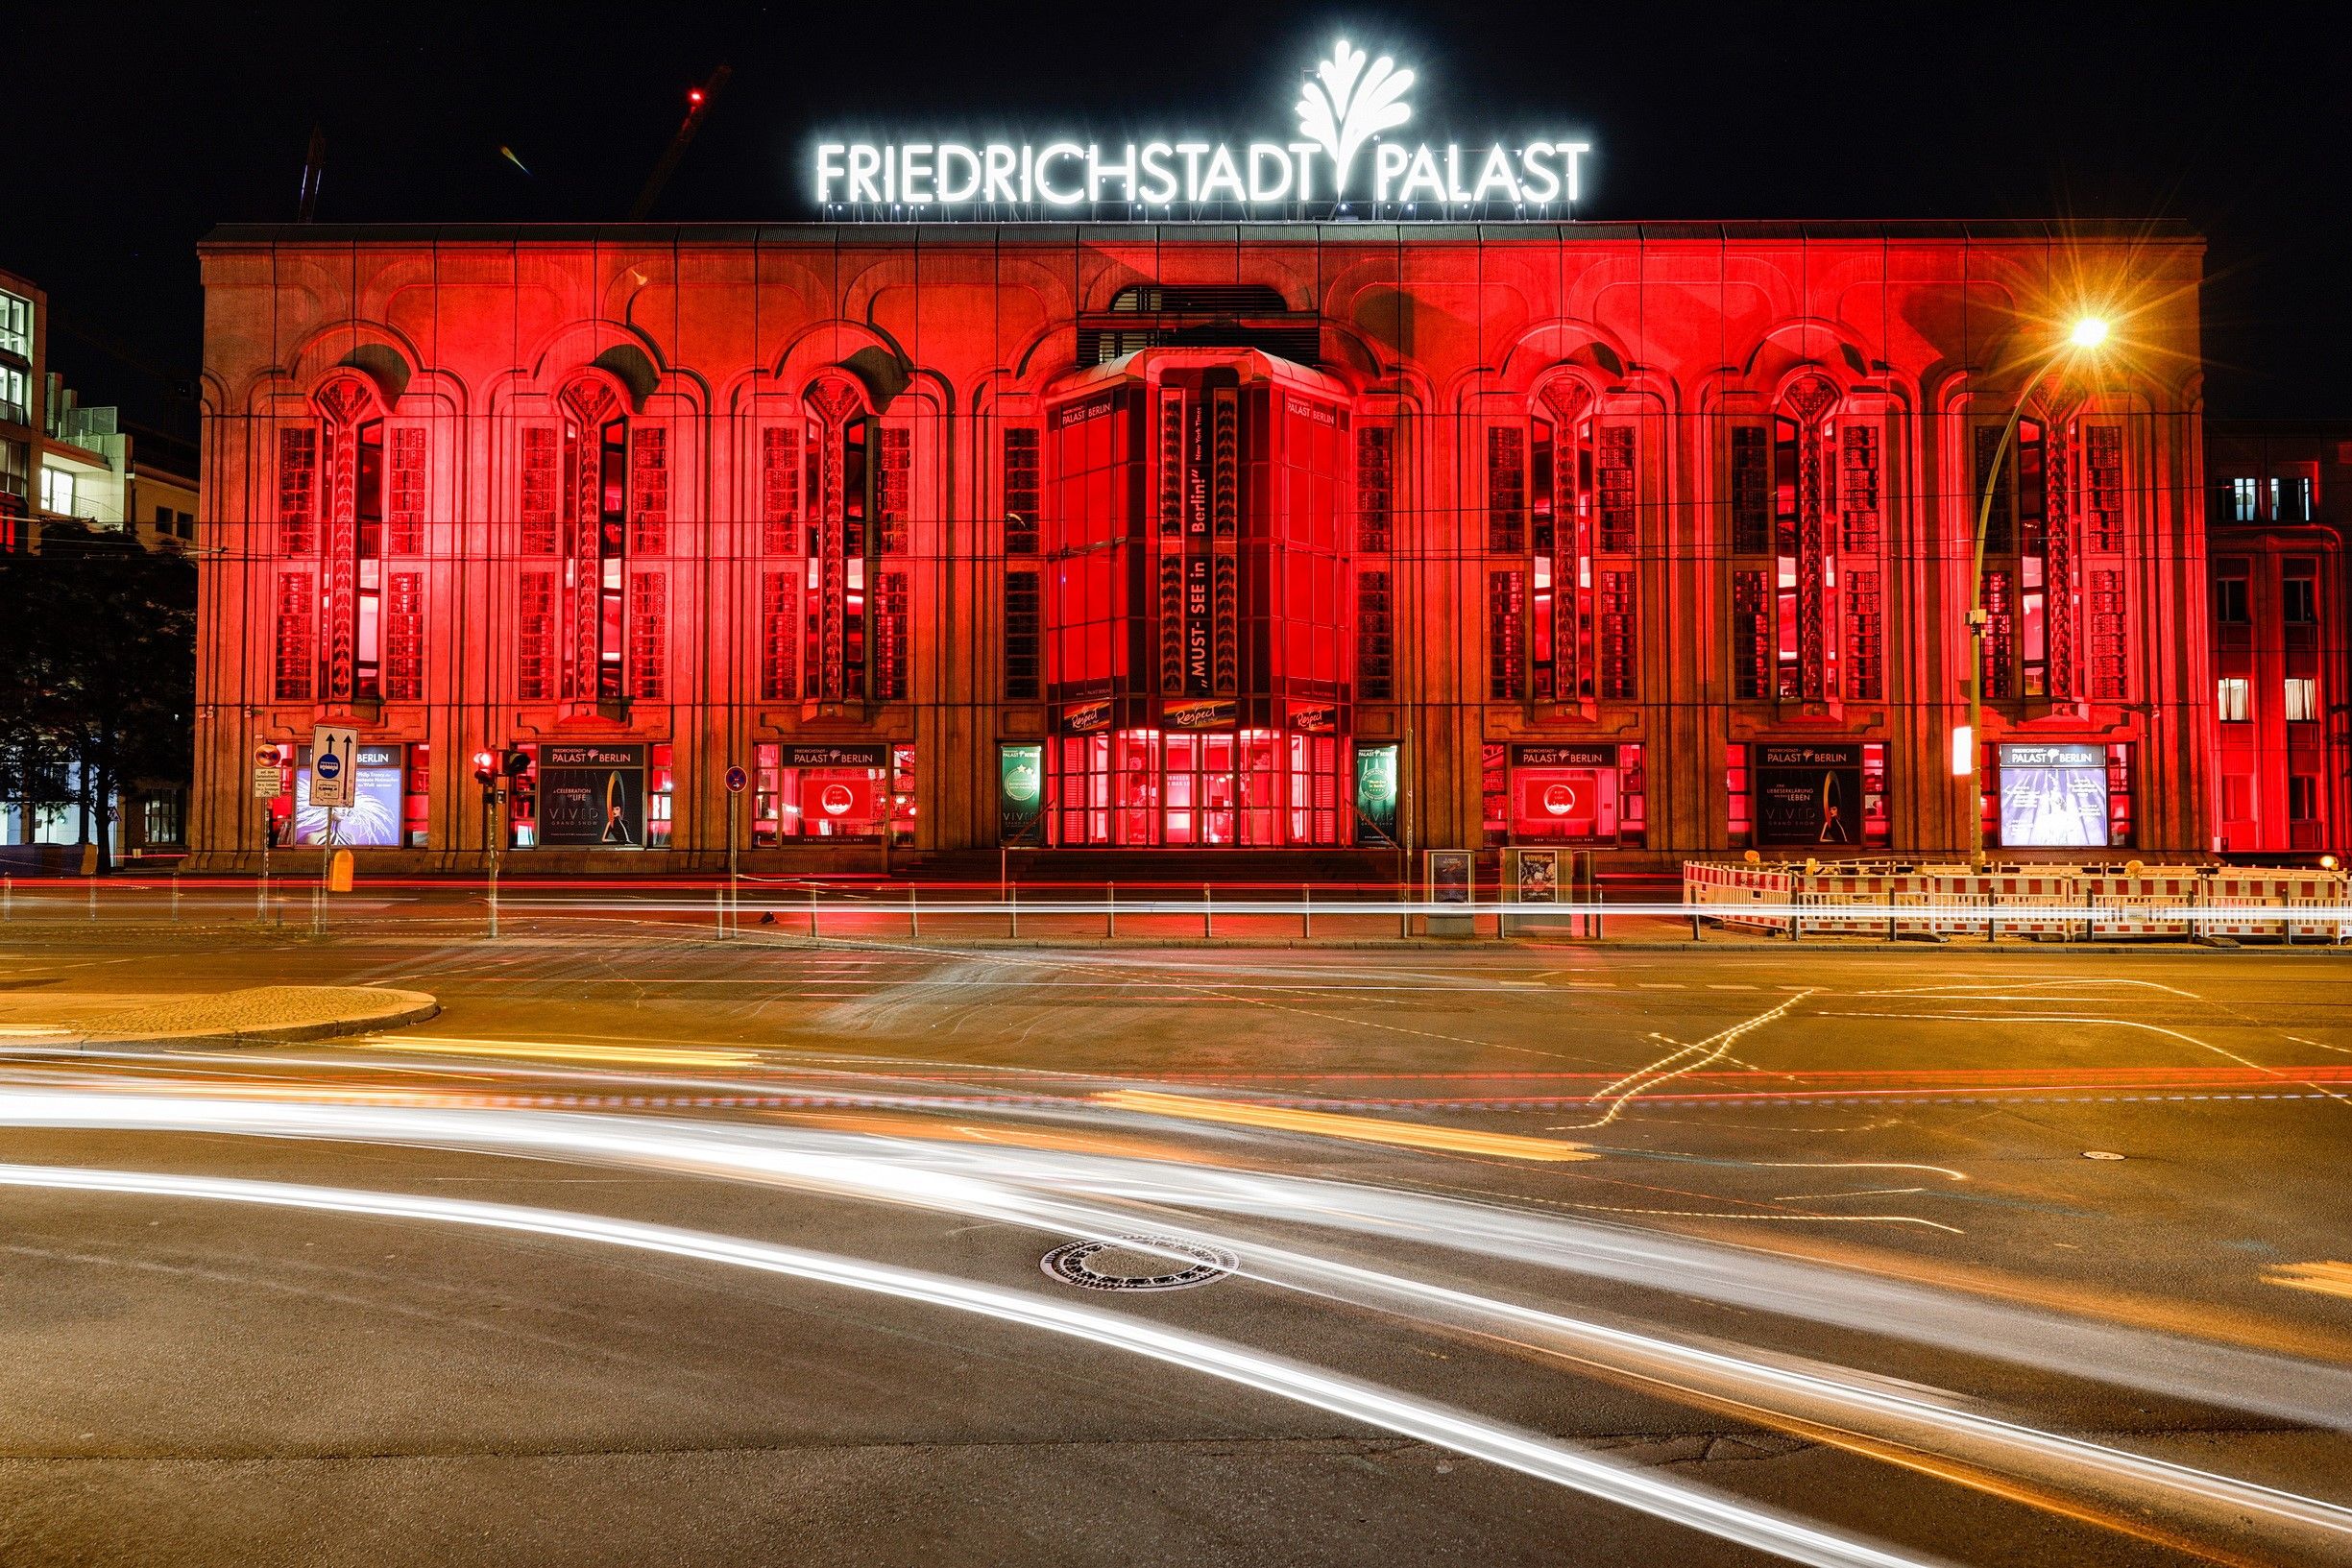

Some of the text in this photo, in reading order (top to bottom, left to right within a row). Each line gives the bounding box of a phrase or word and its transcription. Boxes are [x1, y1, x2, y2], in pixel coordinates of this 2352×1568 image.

[817, 142, 1590, 204] FRIEDRICHSTADT PALAST
[1062, 410, 1085, 425] PALAST
[1088, 402, 1111, 418] BERLIN
[1287, 402, 1311, 418] PALAST
[1313, 410, 1335, 424] BERLIN
[1190, 562, 1205, 578] in
[1190, 584, 1205, 615] SEE
[1175, 705, 1216, 726] Respect
[356, 753, 389, 763] BERLIN
[552, 753, 631, 761] PALAST BERLIN
[794, 754, 873, 762] PALAST BERLIN
[1523, 754, 1603, 762] PALAST BERLIN
[1767, 754, 1847, 762] PALAST BERLIN
[2012, 753, 2093, 761] PALAST BERLIN
[1787, 793, 1810, 802] LEBEN
